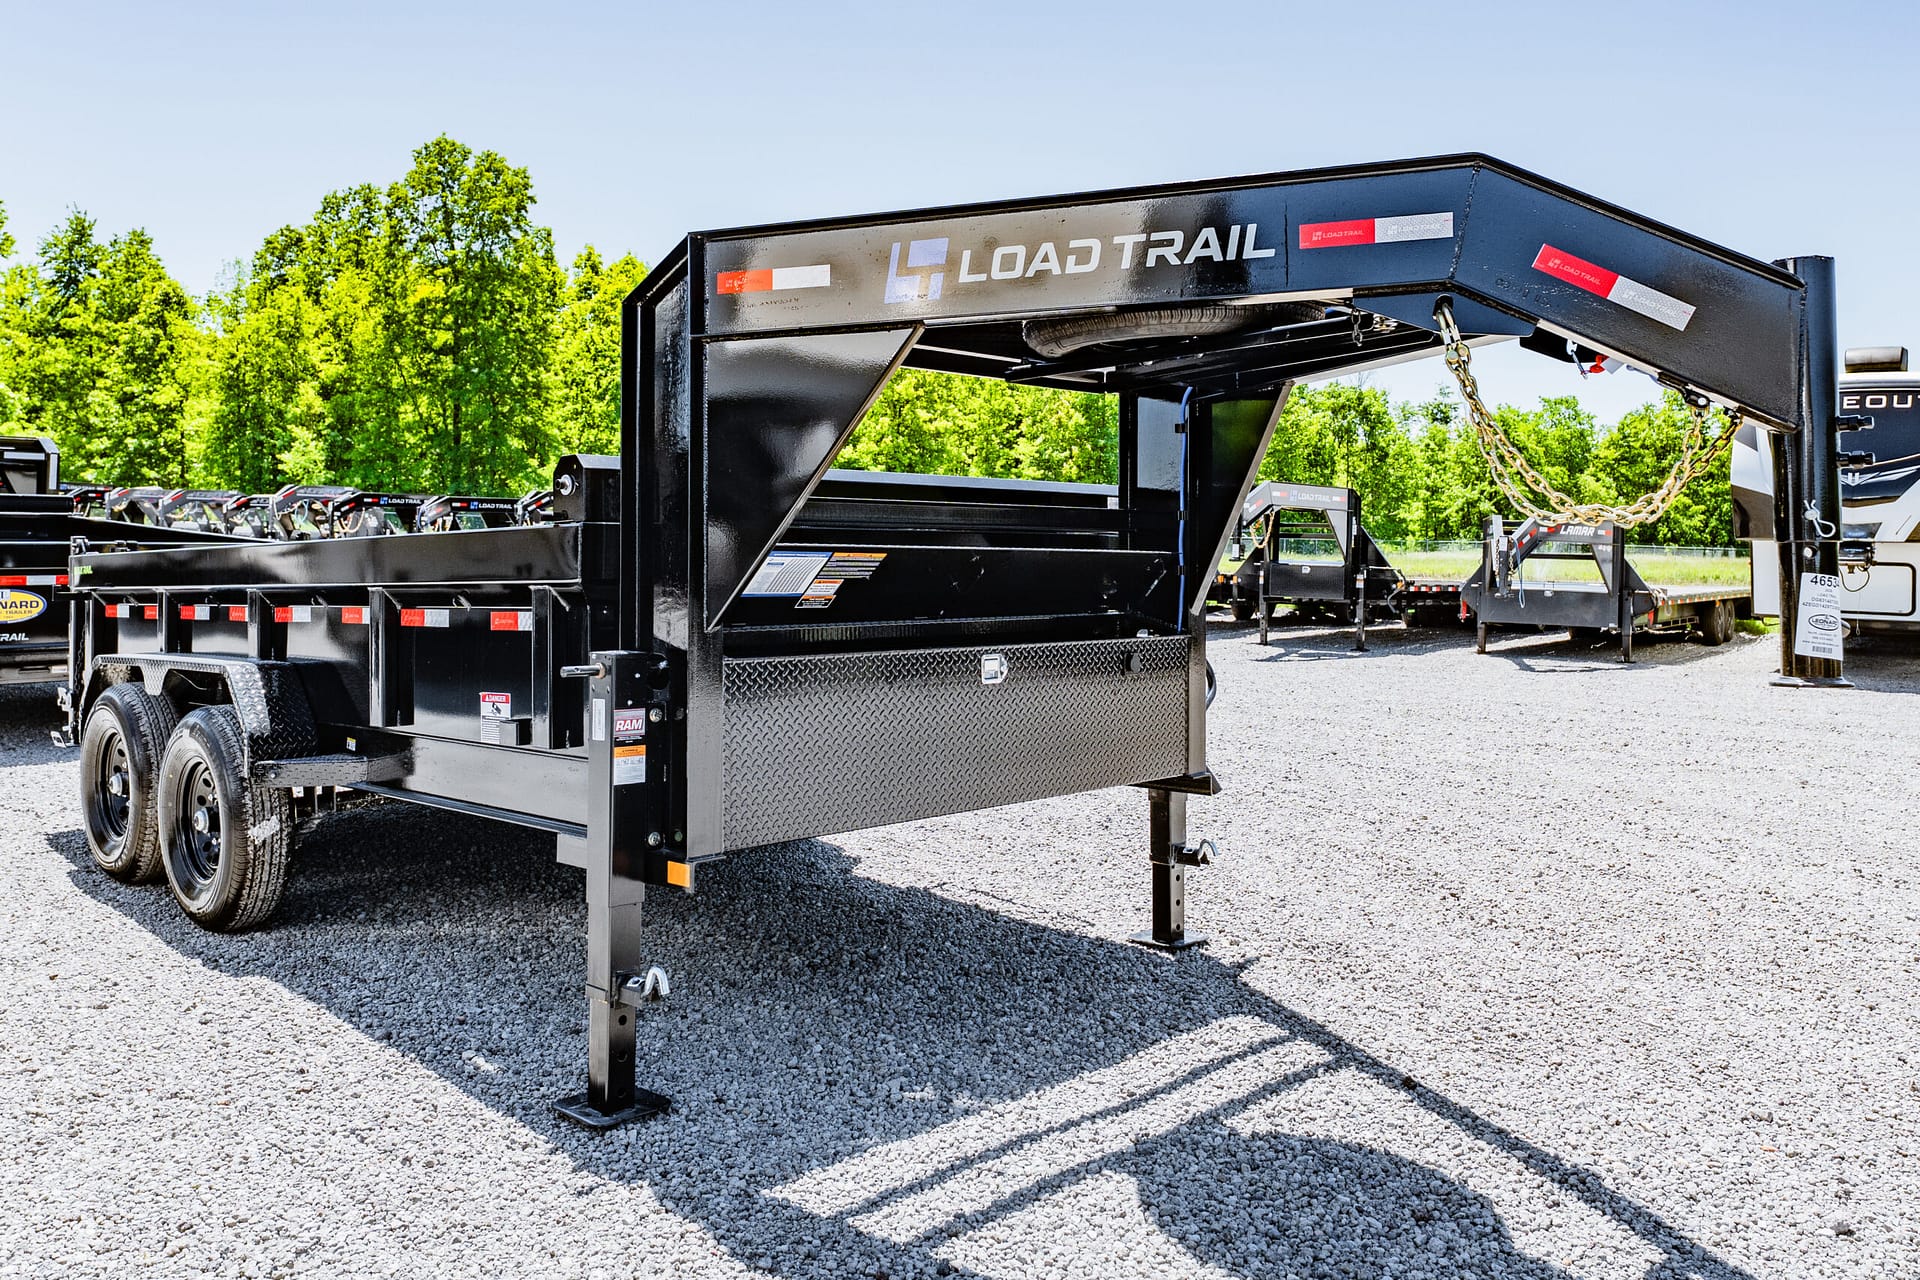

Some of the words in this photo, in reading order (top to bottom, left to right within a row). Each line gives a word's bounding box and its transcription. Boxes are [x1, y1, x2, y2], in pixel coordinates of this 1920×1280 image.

[1322, 231, 1342, 239] LOAD
[1343, 229, 1364, 237] TRAIL
[958, 239, 1101, 283] LOAD
[1112, 223, 1276, 270] TRAIL
[1559, 263, 1581, 277] LOAD
[1842, 394, 1920, 409] EOU
[1560, 525, 1595, 537] LAMAR
[0, 632, 30, 642] RAIL
[615, 719, 643, 732] RAM
